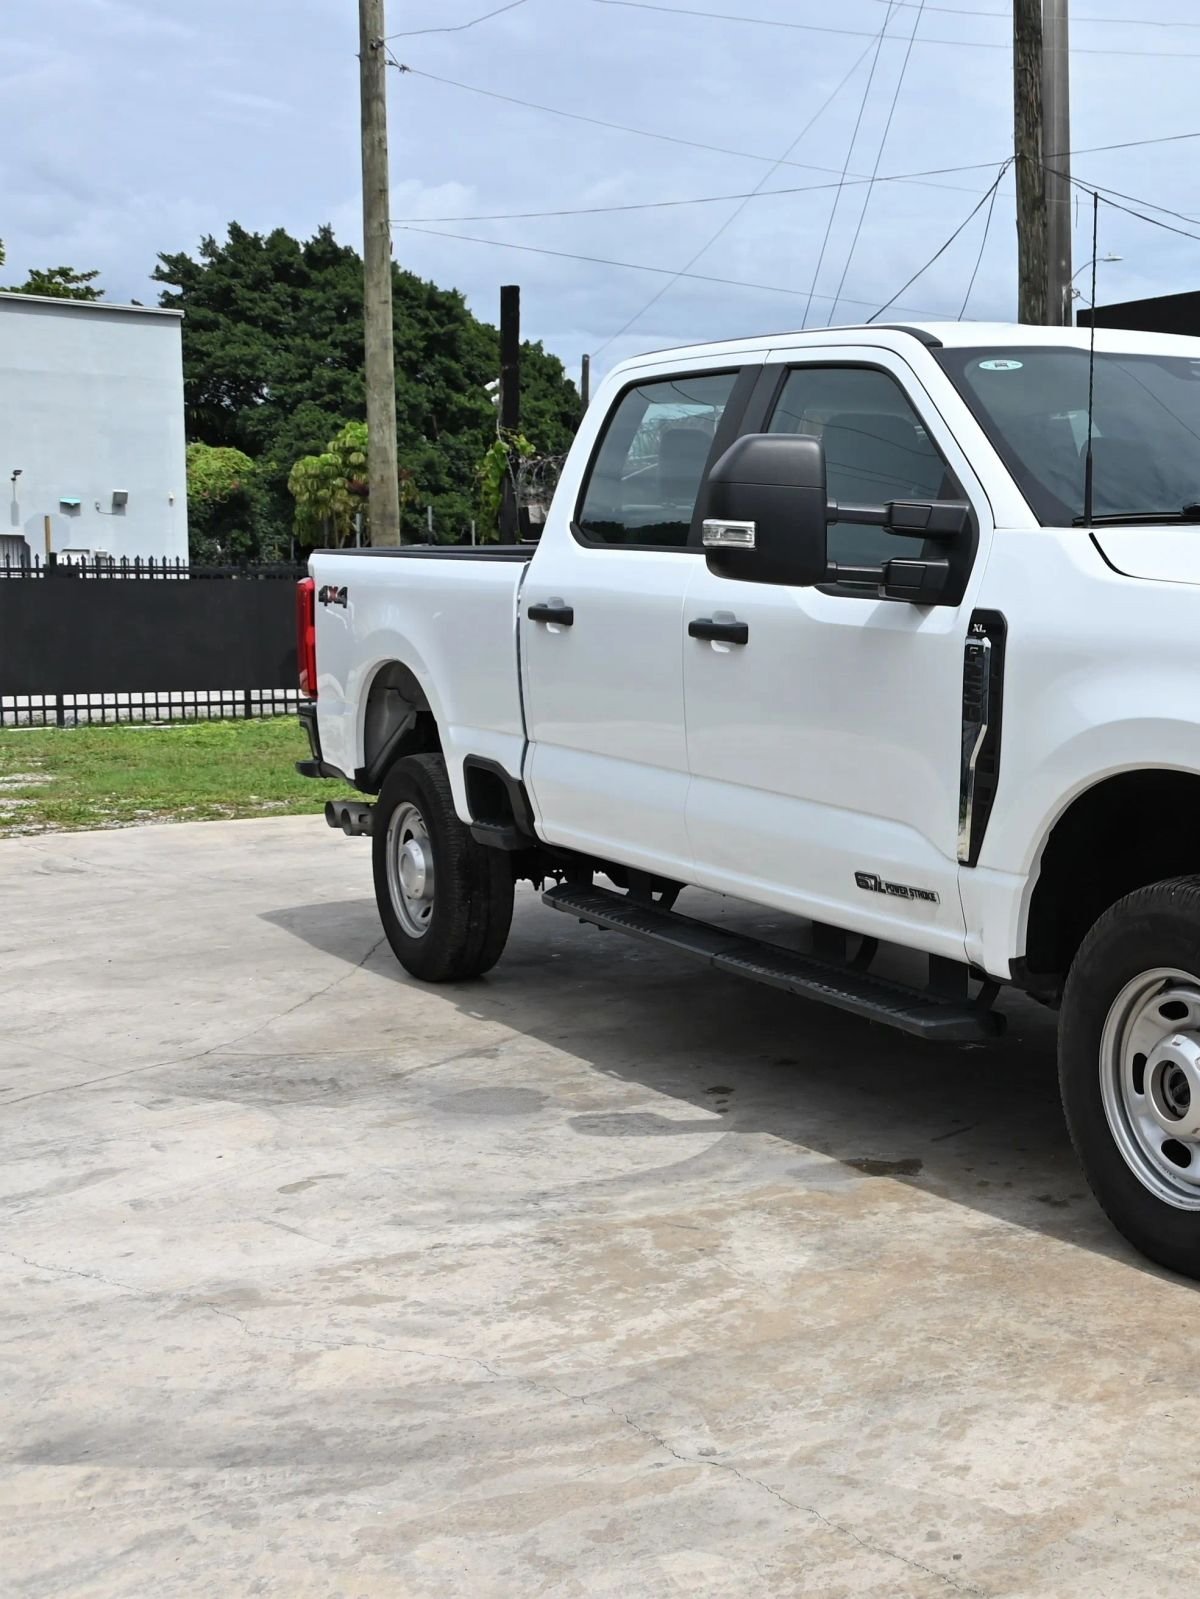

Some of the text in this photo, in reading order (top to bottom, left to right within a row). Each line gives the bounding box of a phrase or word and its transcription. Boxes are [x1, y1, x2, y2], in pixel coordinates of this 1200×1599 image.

[972, 623, 987, 633] XL
[885, 882, 910, 899] POWER
[908, 887, 937, 902] STROKE
